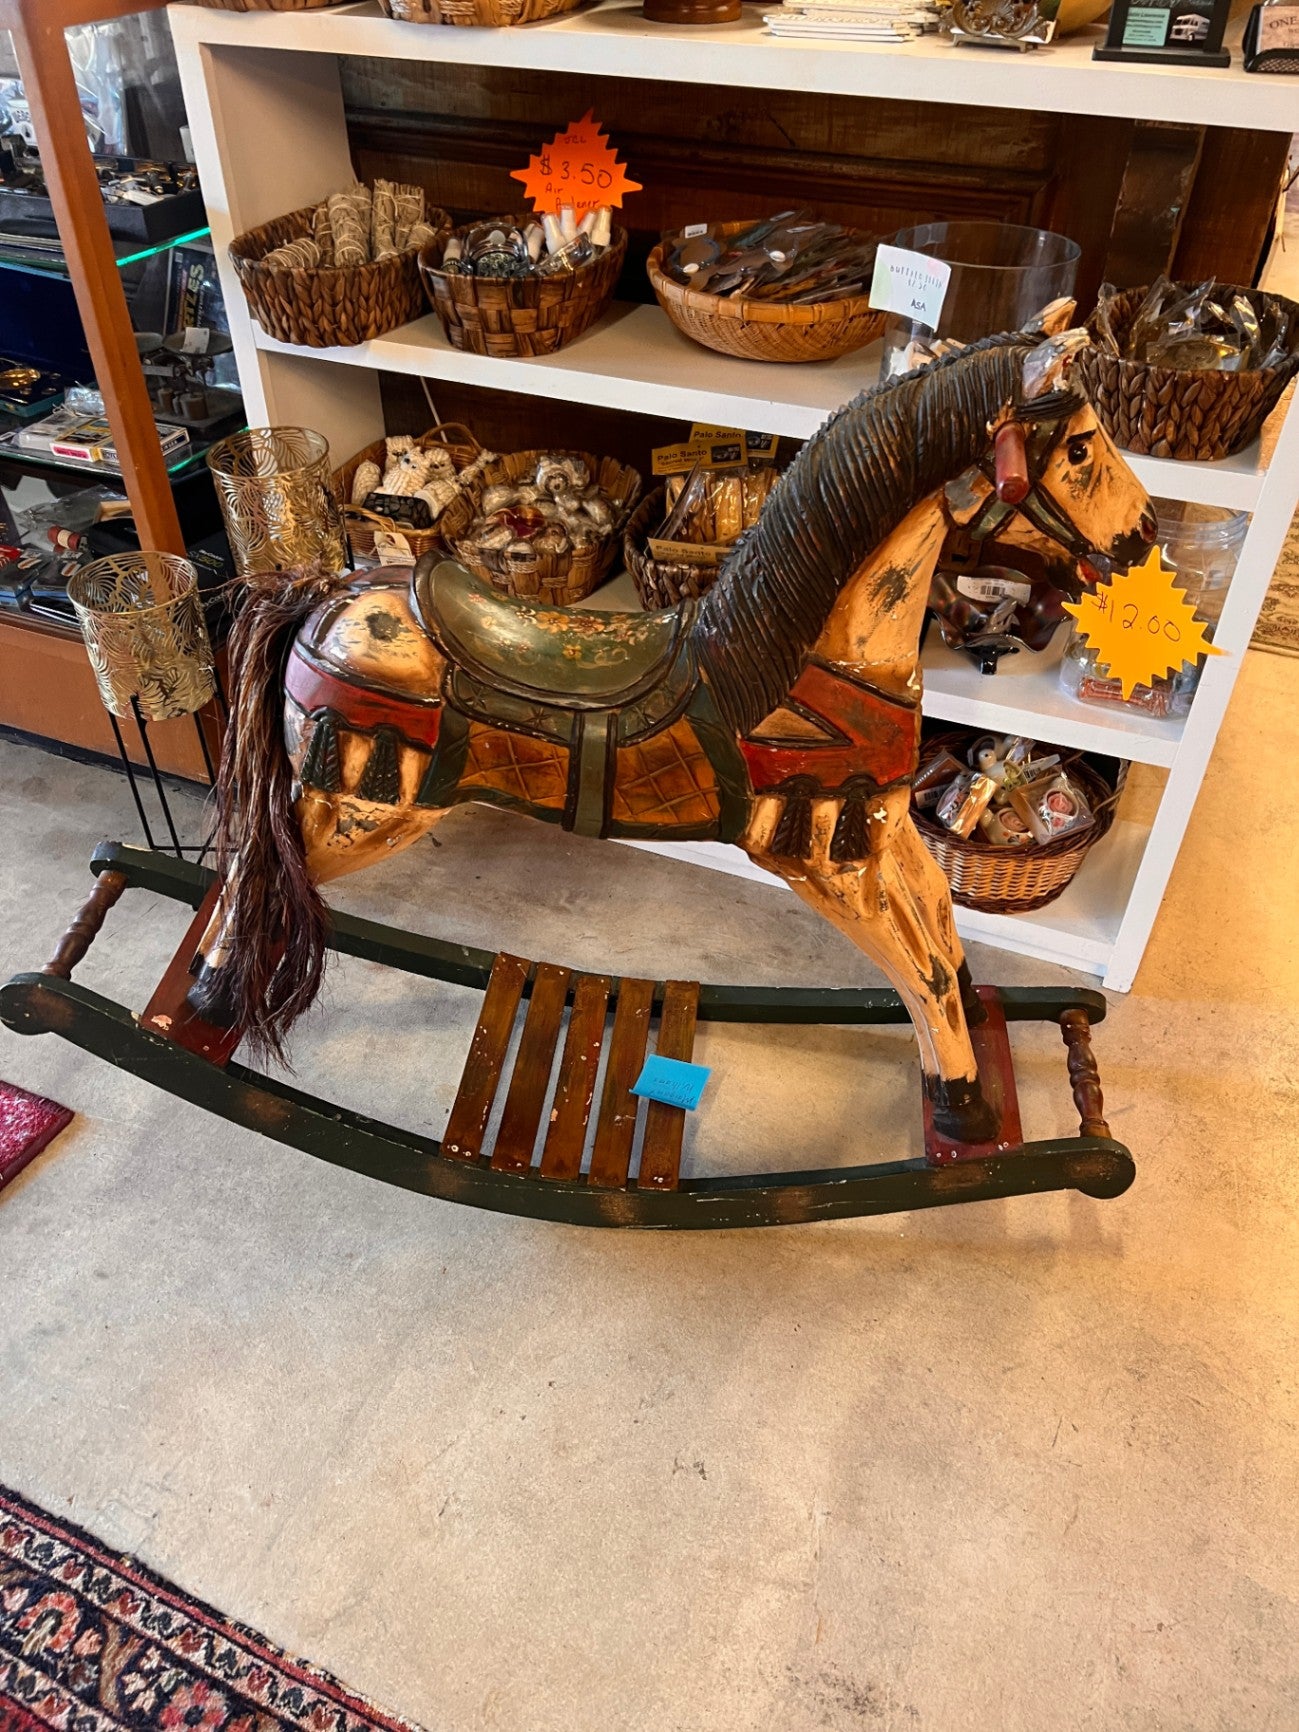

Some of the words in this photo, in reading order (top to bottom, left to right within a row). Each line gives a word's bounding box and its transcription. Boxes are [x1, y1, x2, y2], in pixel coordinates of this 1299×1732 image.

[545, 181, 564, 195] Air
[694, 431, 714, 439] Palo
[657, 452, 678, 462] Palo
[679, 449, 708, 458] Santo
